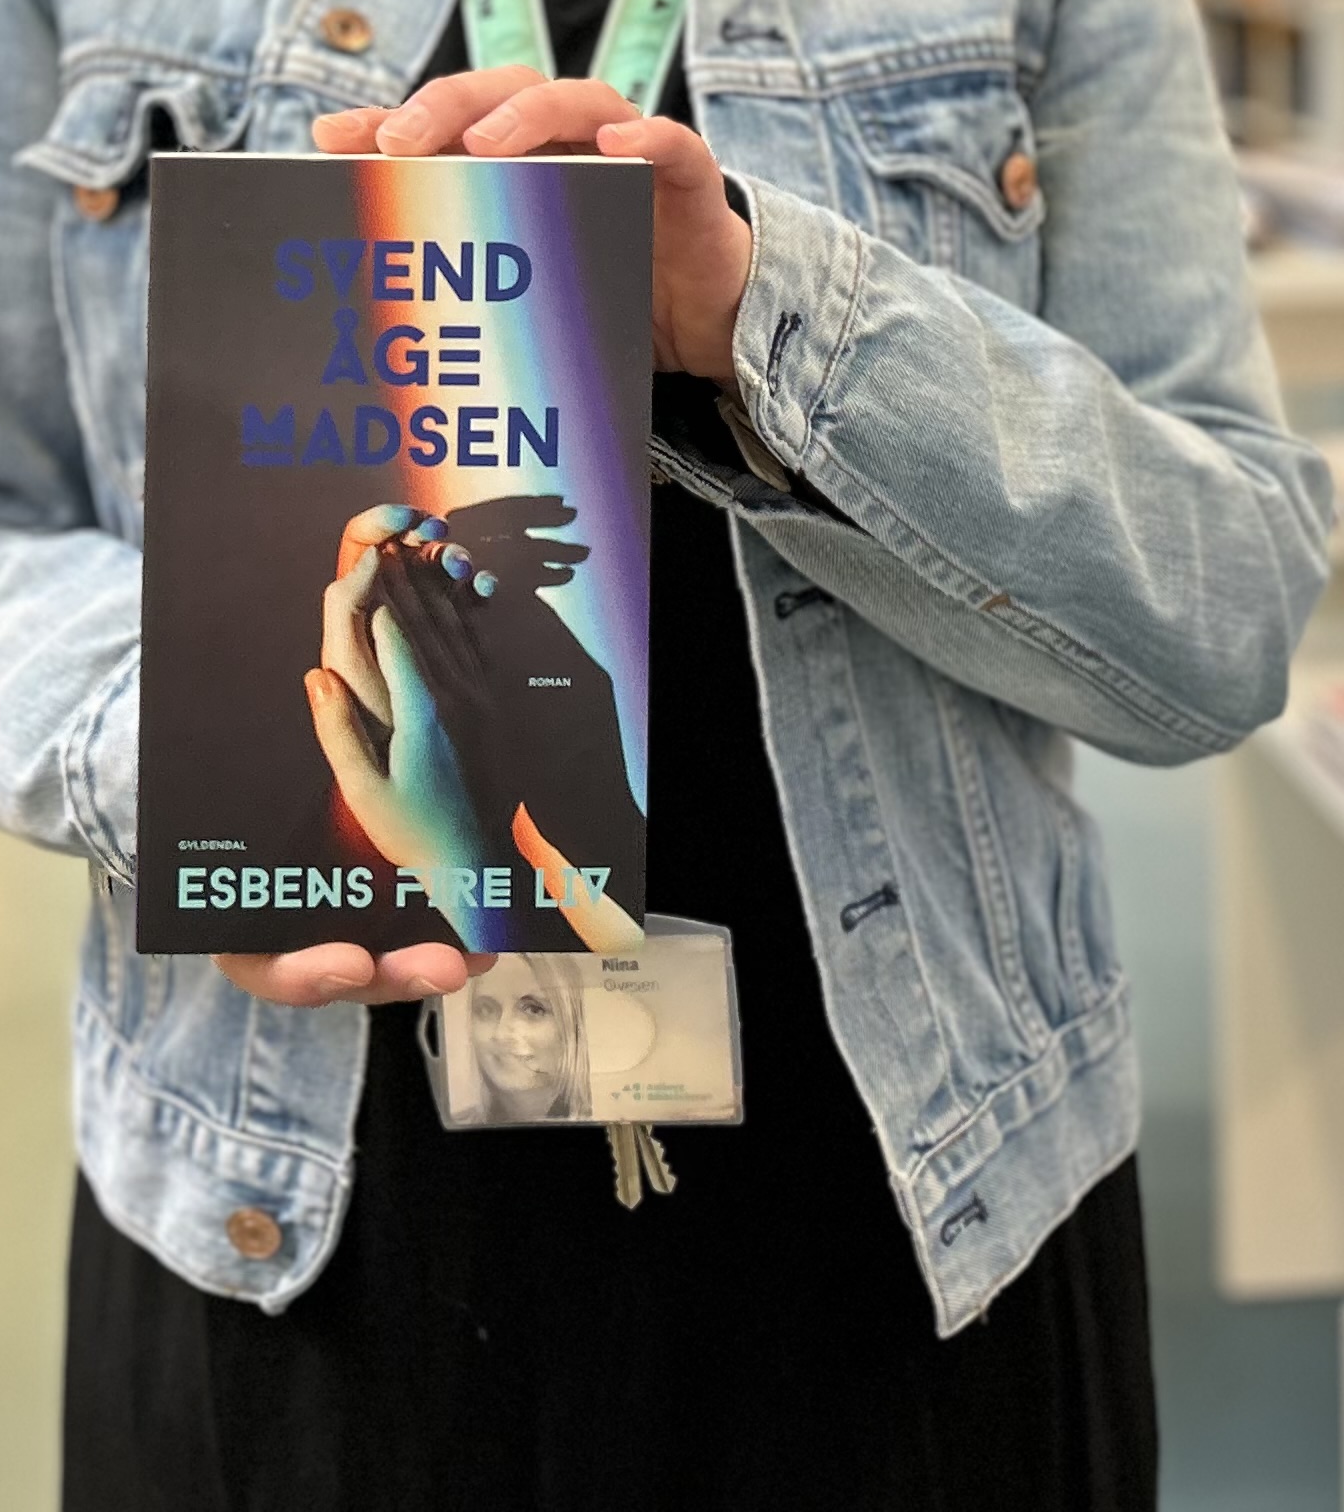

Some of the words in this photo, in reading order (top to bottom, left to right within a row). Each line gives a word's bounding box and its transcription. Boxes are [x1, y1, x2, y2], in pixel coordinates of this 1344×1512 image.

[274, 238, 533, 302] SVEND
[321, 306, 482, 386] ÅGE
[241, 404, 559, 467] MADSEN
[528, 676, 572, 687] ROMAN
[178, 839, 248, 852] GYLDENDAL
[178, 866, 374, 910] ESBENS
[396, 866, 512, 909] FIRE
[535, 866, 612, 909] LIV
[601, 957, 640, 972] Nina
